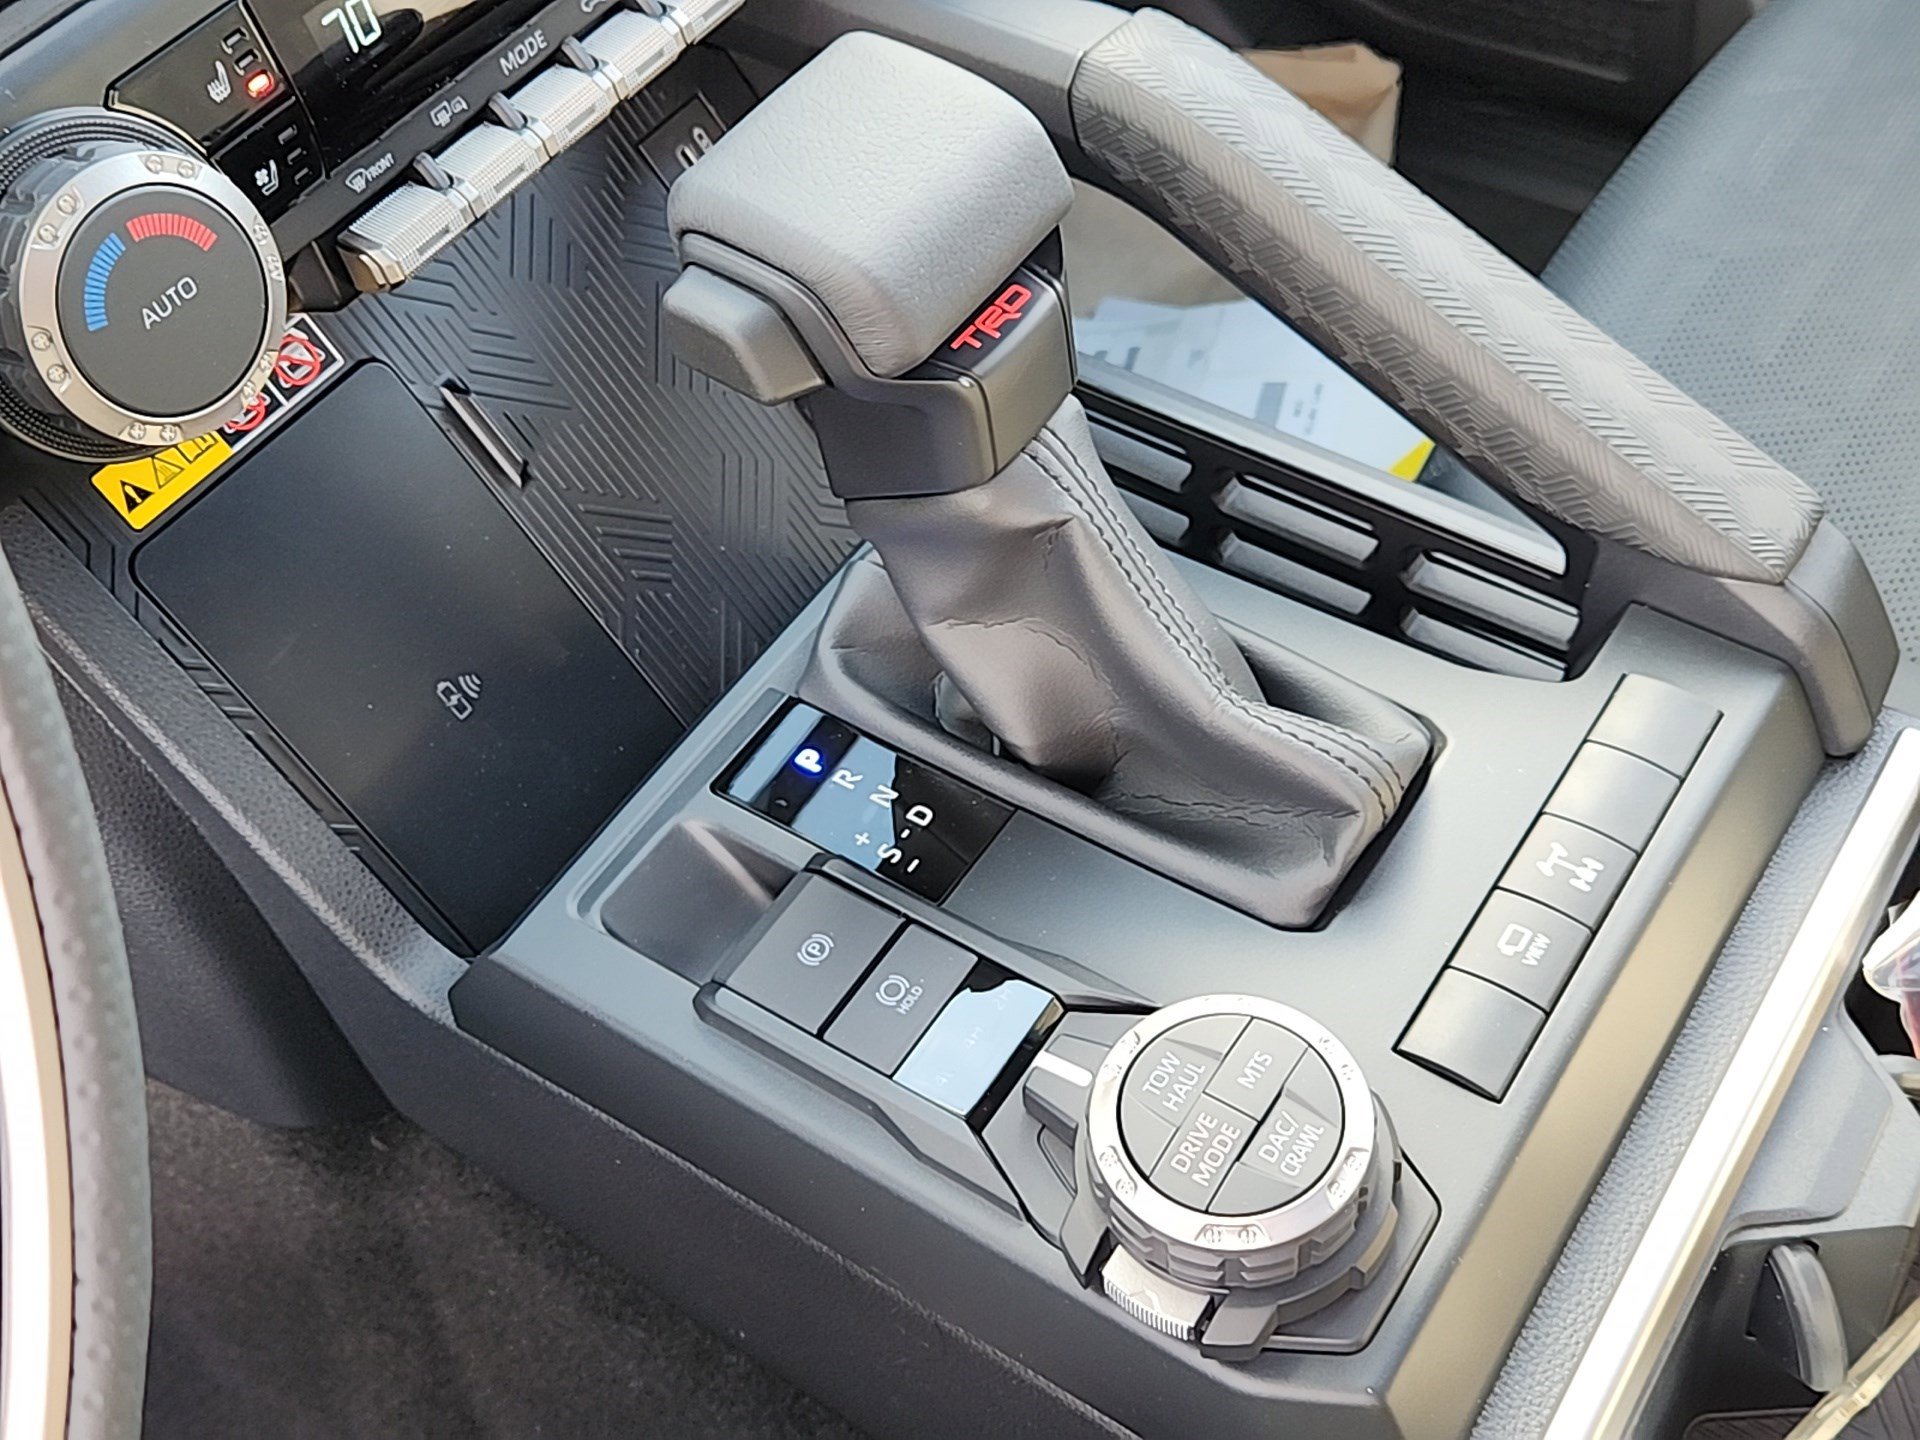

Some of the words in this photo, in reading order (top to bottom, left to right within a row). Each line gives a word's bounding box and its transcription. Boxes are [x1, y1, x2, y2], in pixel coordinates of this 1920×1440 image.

[320, 0, 382, 53] 70
[500, 29, 547, 76] MODE
[366, 152, 396, 184] FRONT
[142, 276, 198, 330] AUTO
[950, 283, 1032, 350] TRD
[794, 748, 822, 773] P
[832, 769, 863, 790] R
[869, 784, 899, 808] N
[905, 804, 933, 827] D
[876, 843, 902, 864] S
[896, 985, 924, 1015] HOLD
[1142, 1051, 1182, 1096] TOW
[1162, 1063, 1206, 1112] HAUL
[1236, 1050, 1273, 1090] MTS
[1170, 1112, 1218, 1174] DRIVE
[1191, 1122, 1241, 1186] MODE
[1258, 1110, 1299, 1163] DAC/
[1280, 1123, 1325, 1177] CRAWL
